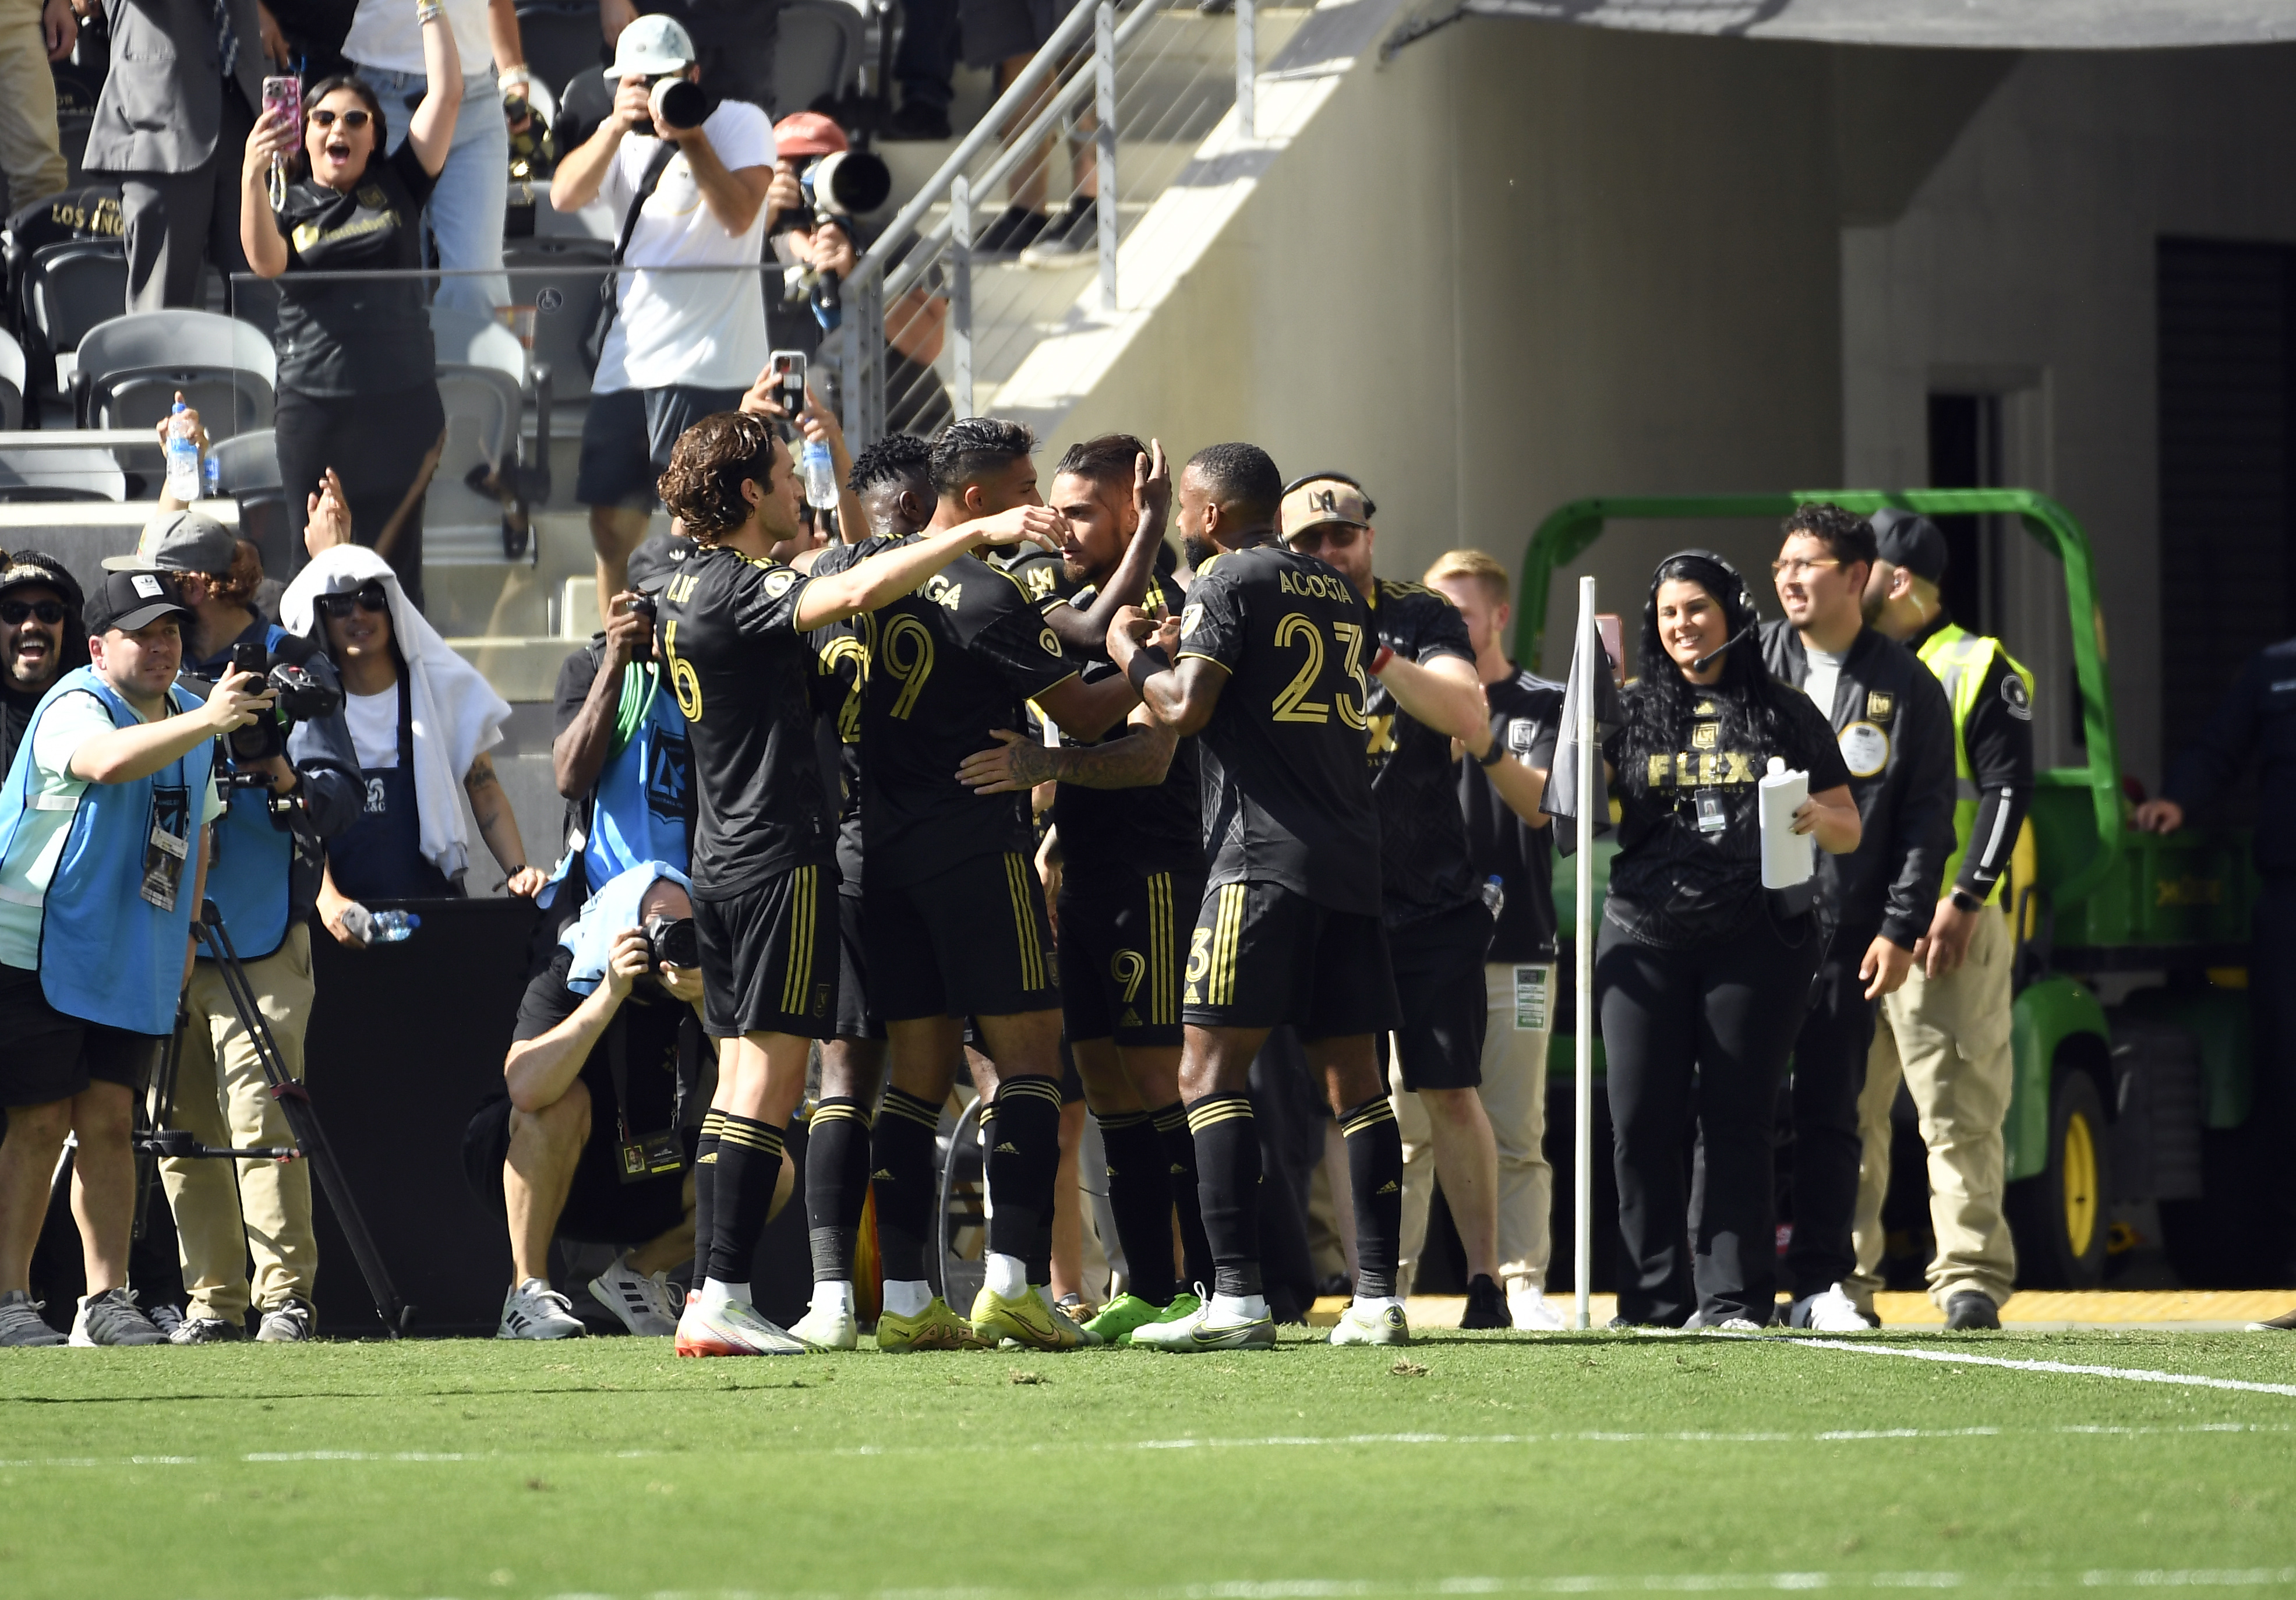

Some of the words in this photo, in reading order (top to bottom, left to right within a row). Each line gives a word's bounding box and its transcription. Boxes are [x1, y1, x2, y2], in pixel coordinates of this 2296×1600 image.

[52, 203, 84, 228] LOS
[1279, 569, 1354, 605] ACOSTA
[664, 620, 704, 723] 6
[1272, 612, 1368, 731] 23
[1648, 751, 1755, 787] FLEX
[1111, 948, 1146, 1002] 9
[1185, 927, 1213, 983] 3
